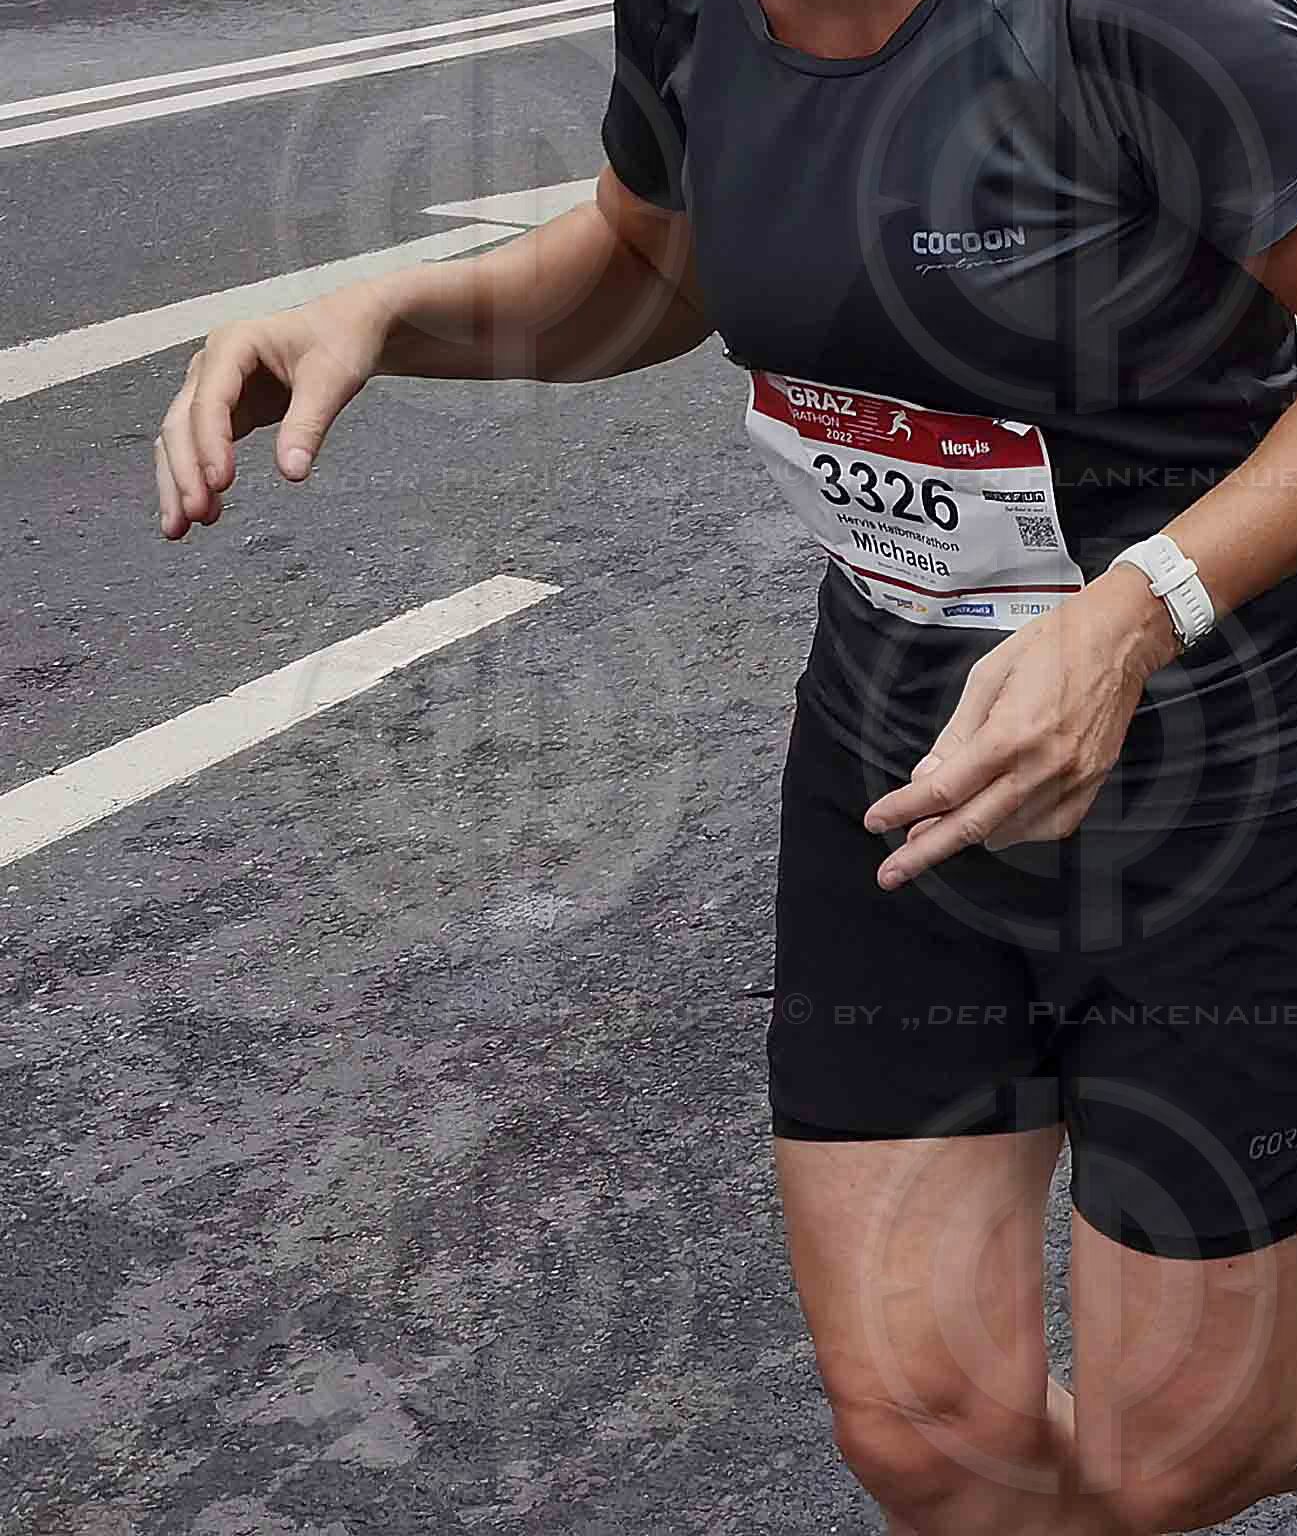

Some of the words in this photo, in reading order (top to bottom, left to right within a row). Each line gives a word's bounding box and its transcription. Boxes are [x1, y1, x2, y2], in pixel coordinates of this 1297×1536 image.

[912, 225, 1026, 255] COCOON
[787, 384, 857, 416] GRAZ
[792, 409, 840, 428] RATHON
[826, 428, 853, 443] 2022
[941, 439, 990, 457] Hervis
[812, 453, 959, 532] 3326
[836, 513, 877, 530] Hervis
[878, 522, 960, 553] Halbmarathon
[850, 528, 951, 577] Michaela
